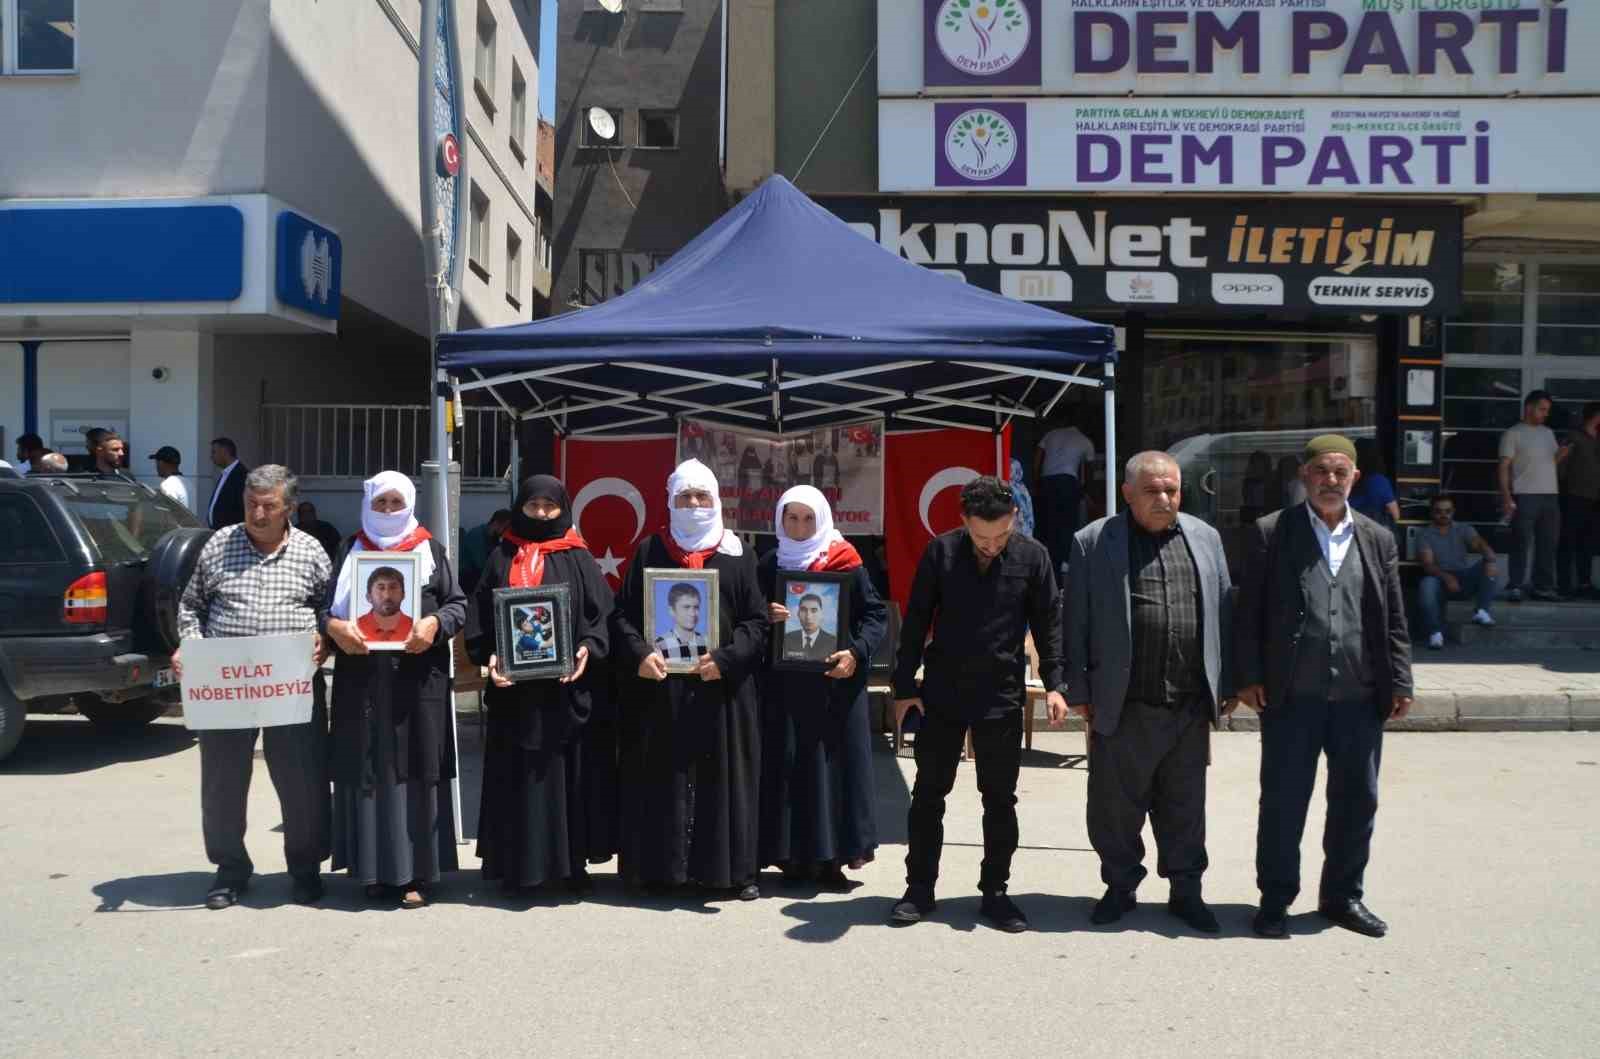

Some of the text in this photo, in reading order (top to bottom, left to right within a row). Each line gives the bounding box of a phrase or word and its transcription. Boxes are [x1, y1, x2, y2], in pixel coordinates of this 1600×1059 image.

[1074, 11, 1260, 74] DEM
[957, 55, 978, 70] DEM
[1076, 122, 1137, 132] HALKLARIN
[1139, 121, 1181, 133] EŞİTLİK
[1183, 122, 1195, 132] VE
[1198, 121, 1260, 133] DEMOKRASİ
[1076, 120, 1489, 185] DEM PARTİ
[1228, 215, 1435, 275] İLETİŞİM
[1222, 283, 1273, 294] oppo
[1314, 283, 1429, 298] TEKNİK SERVİS
[221, 664, 273, 679] EVLAT
[189, 680, 312, 701] NÖBETİNDEYİZ
